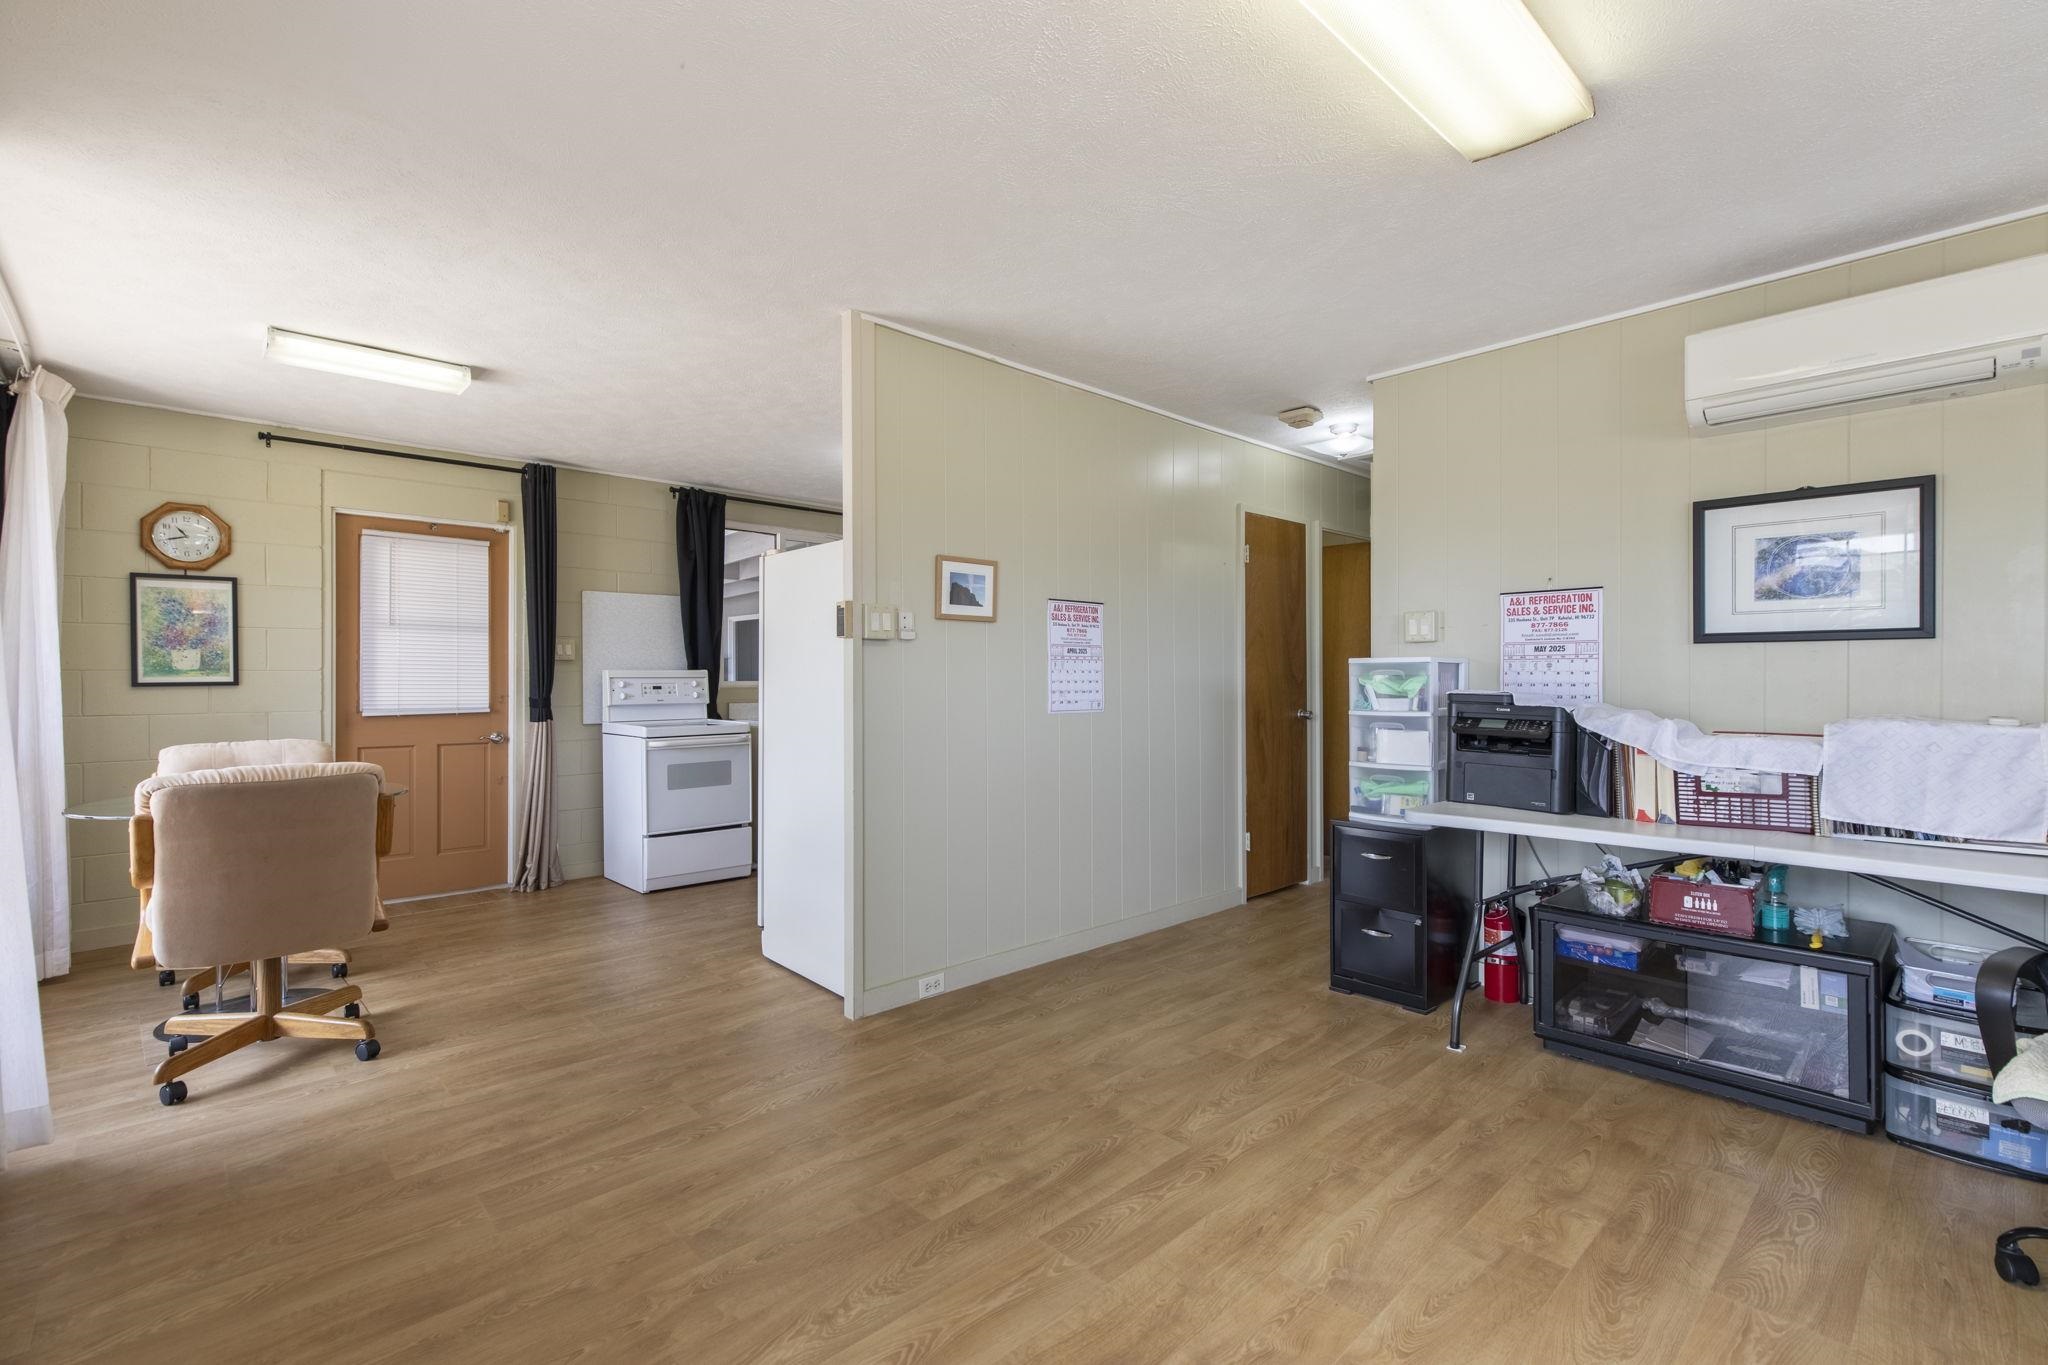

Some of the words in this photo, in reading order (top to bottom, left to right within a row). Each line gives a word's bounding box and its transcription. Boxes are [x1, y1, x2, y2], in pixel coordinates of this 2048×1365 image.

[1529, 593, 1593, 605] REFRIGERATION
[1064, 605, 1099, 614] REFRIGERATION
[1506, 606, 1531, 617] SALES
[1533, 607, 1540, 615] &
[1543, 604, 1577, 615] SERVICE
[1579, 603, 1597, 613] INC.
[1051, 613, 1067, 621] SALES
[1073, 614, 1091, 623] SERVICE
[1534, 645, 1548, 653] MAY
